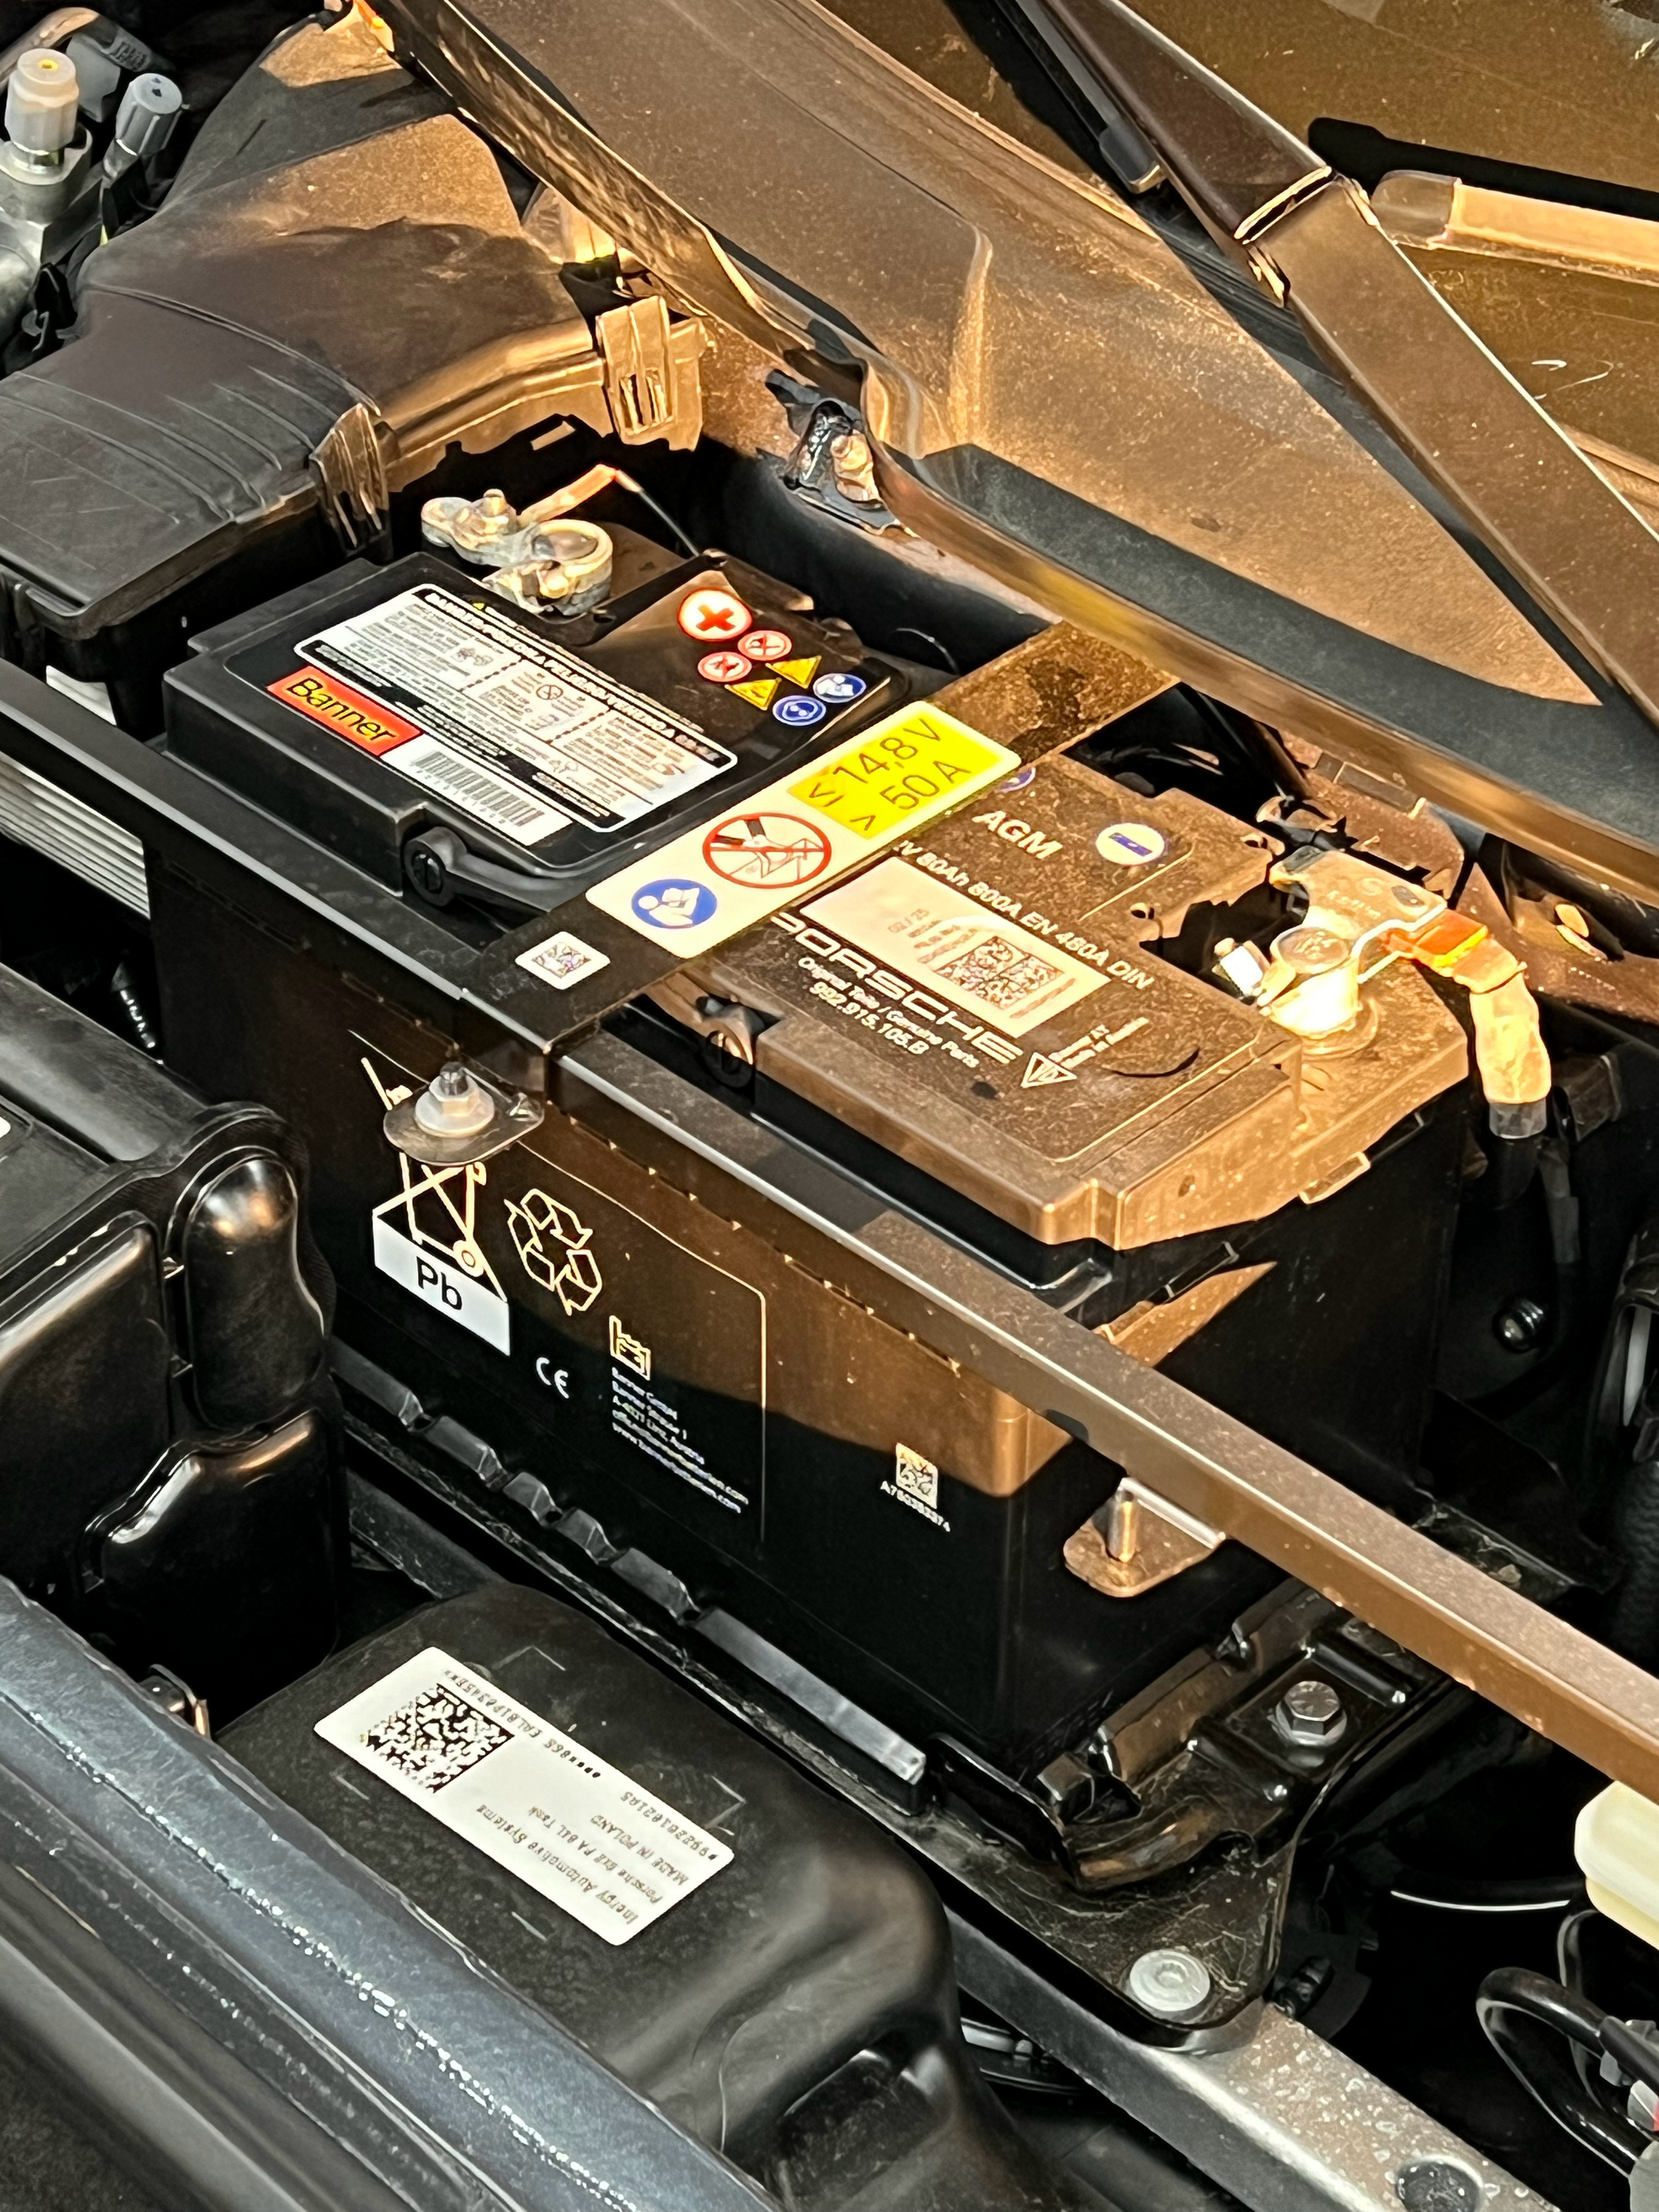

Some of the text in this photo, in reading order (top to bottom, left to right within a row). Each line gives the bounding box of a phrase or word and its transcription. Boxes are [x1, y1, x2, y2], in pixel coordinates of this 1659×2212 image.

[286, 678, 396, 741] Banner
[903, 719, 940, 742] V
[879, 775, 940, 810] 50
[933, 760, 972, 784] A
[972, 810, 1063, 860] AGM
[916, 851, 970, 887] 80Ah
[968, 881, 1024, 919] 800A
[1020, 911, 1058, 935] EN
[1107, 959, 1155, 990] DIN
[770, 912, 1024, 1064] PORSCHE
[941, 1041, 980, 1068] Parts
[416, 1256, 462, 1310] Pb
[536, 1357, 569, 1398] CE
[591, 1815, 689, 1886] MADE IN POLAND
